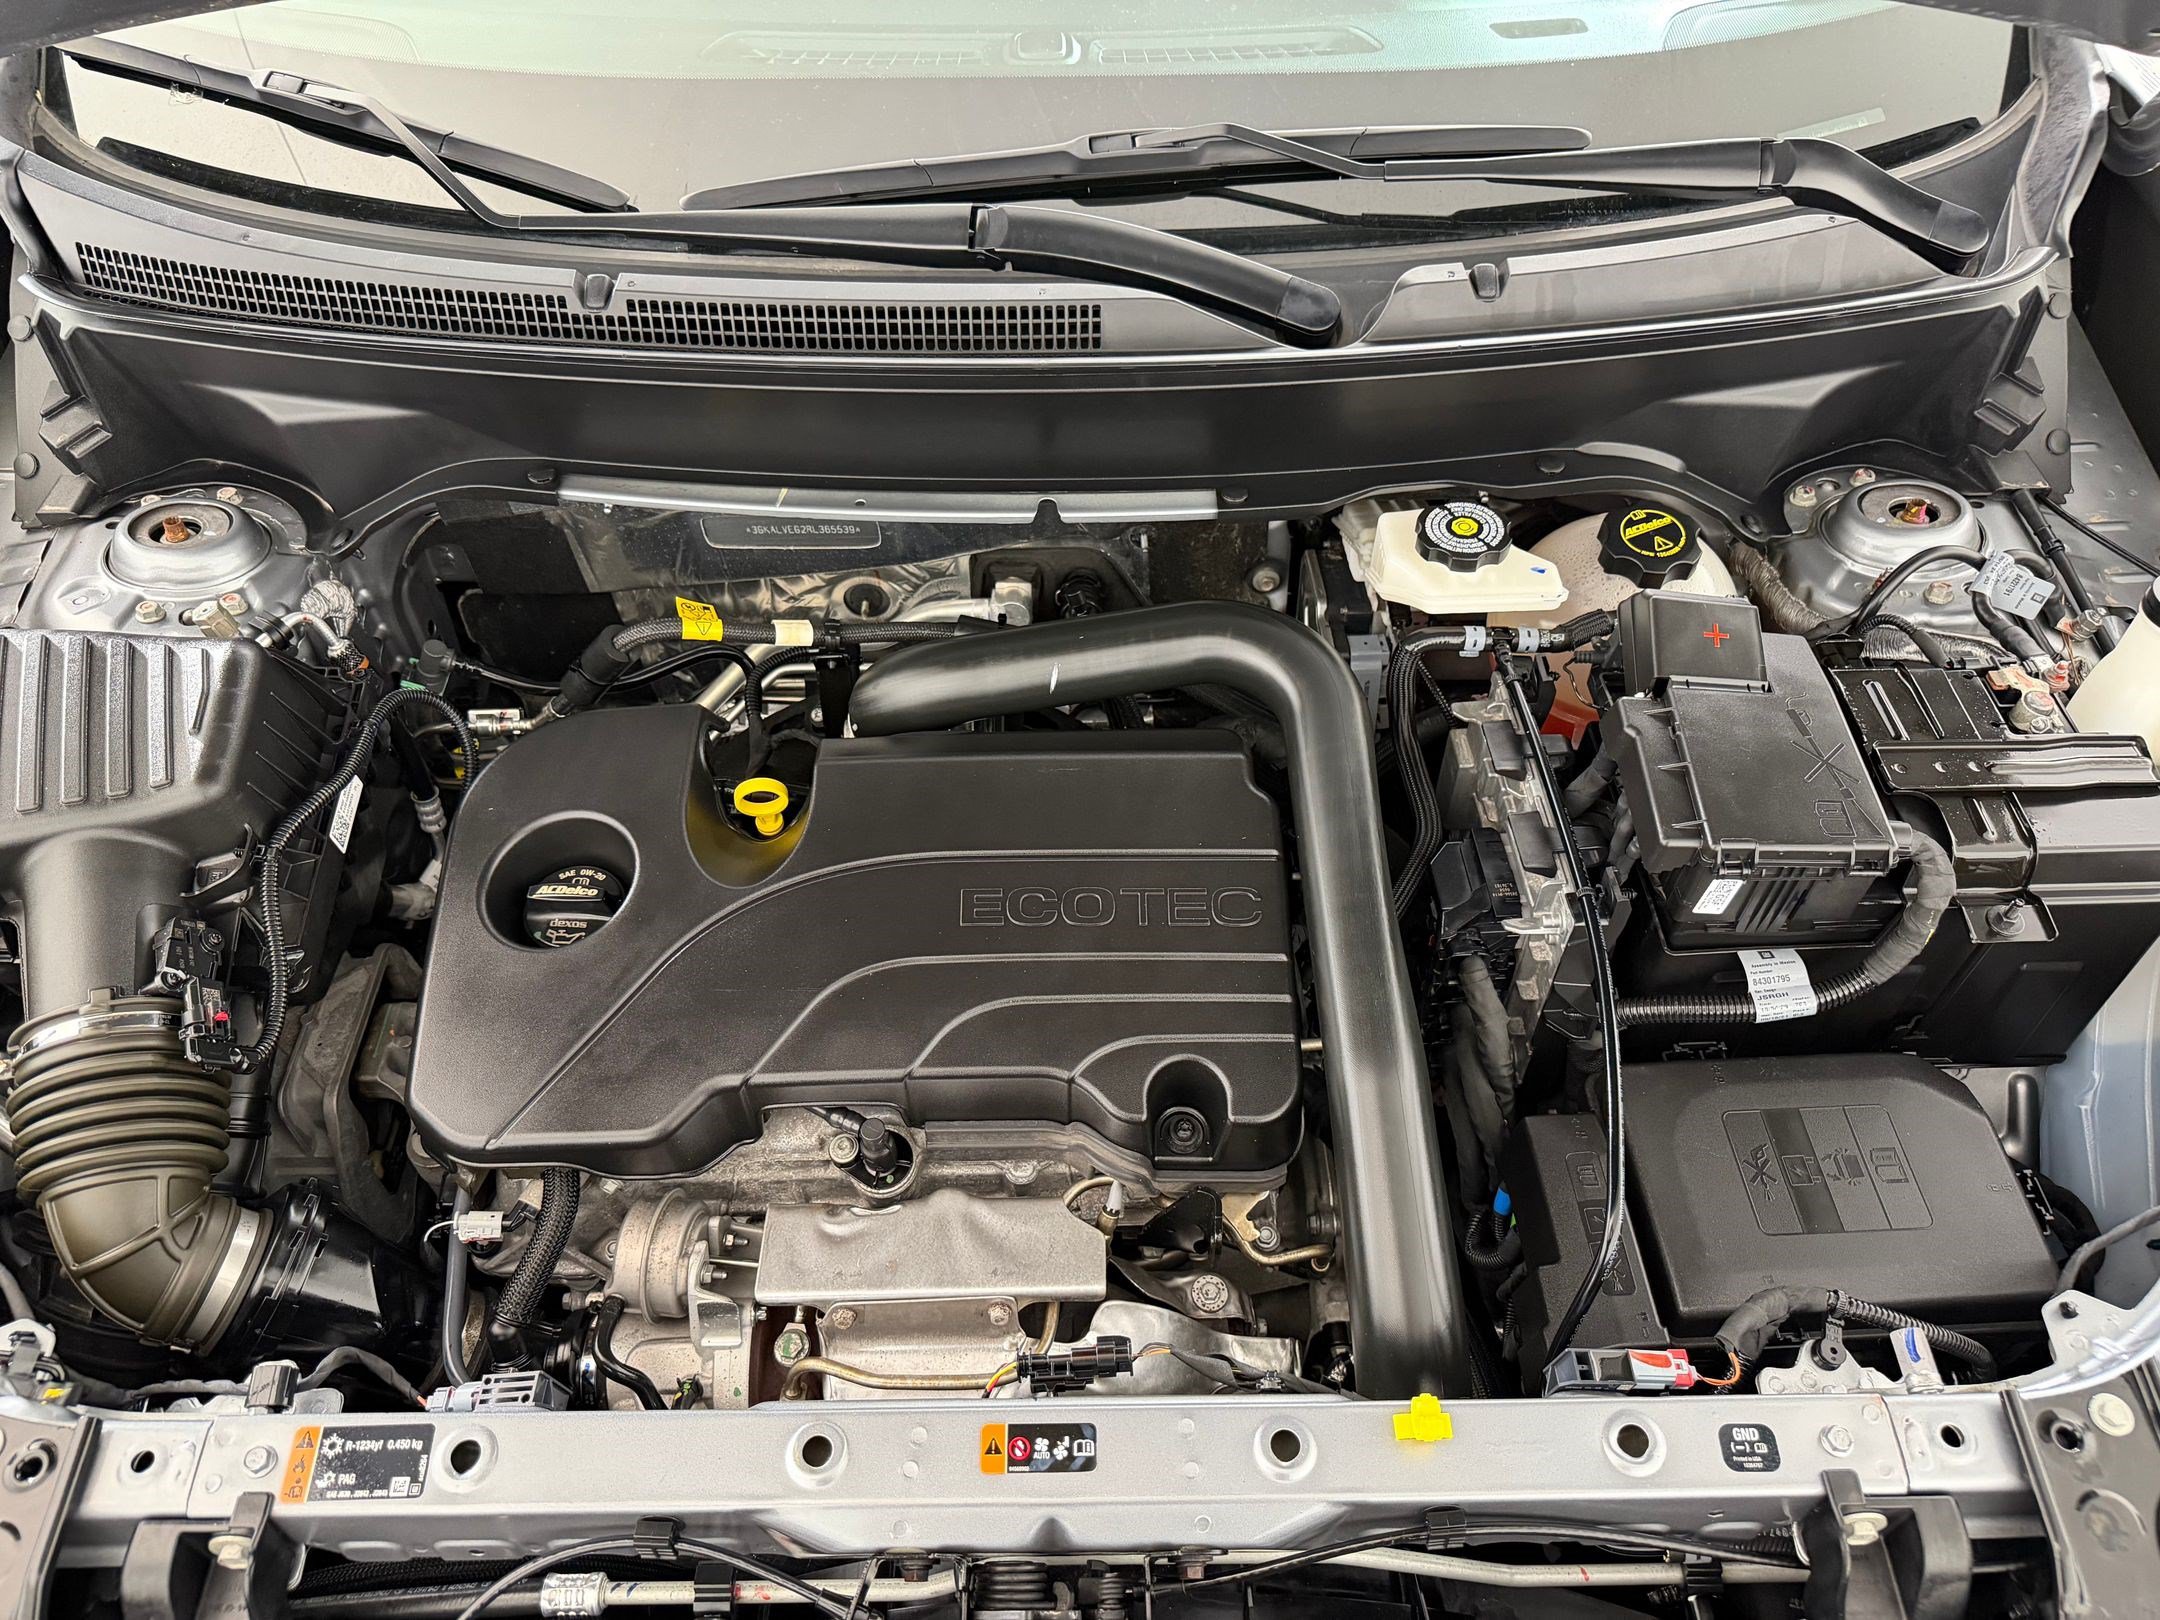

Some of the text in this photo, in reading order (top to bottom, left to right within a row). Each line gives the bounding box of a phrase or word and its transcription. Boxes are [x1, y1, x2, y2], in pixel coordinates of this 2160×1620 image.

[1625, 516, 1672, 536] ACDelco
[559, 869, 607, 881] SAE 0W-20
[535, 885, 599, 896] ACDelco
[960, 887, 1263, 927] ECOTEC
[549, 919, 588, 929] dexos
[1752, 974, 1791, 986] 84301795
[1732, 1427, 1760, 1441] GND
[387, 1439, 410, 1450] 0.450
[411, 1438, 424, 1451] kg
[1033, 1451, 1051, 1459] AUTO
[338, 1473, 356, 1485] PAG
